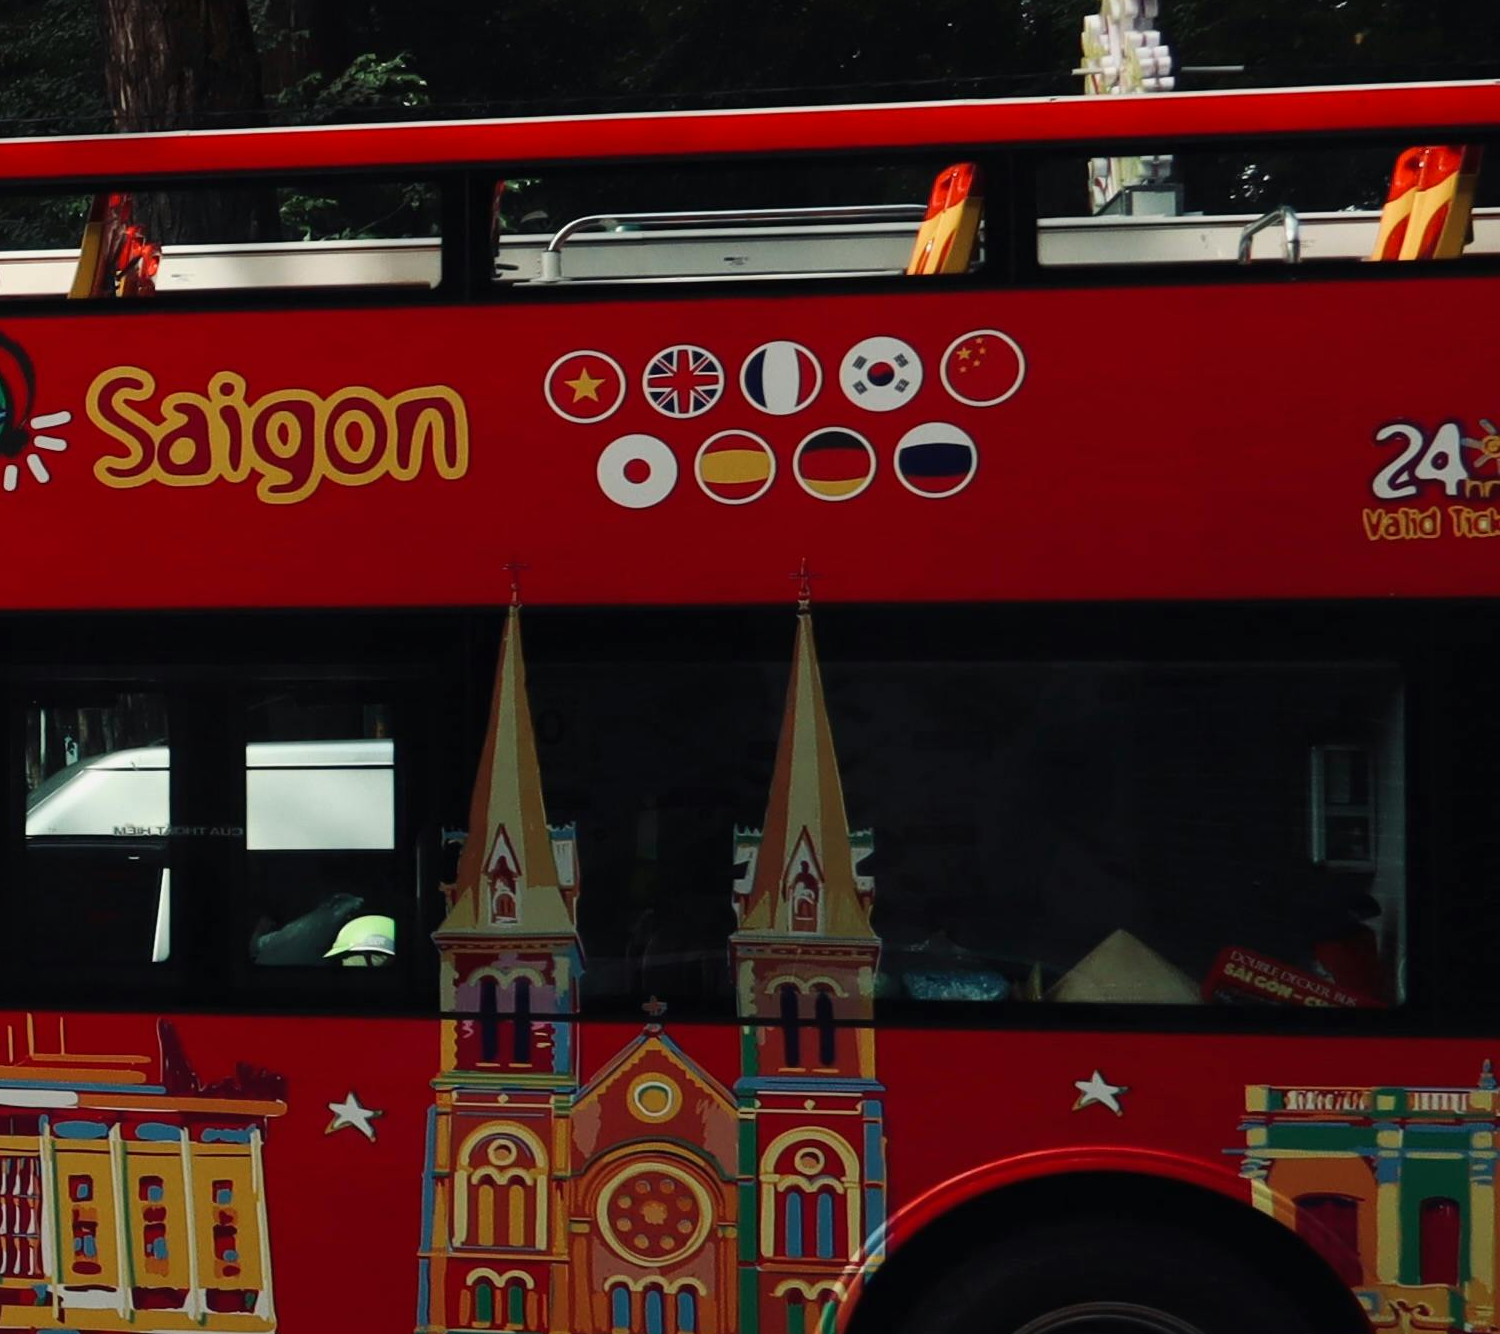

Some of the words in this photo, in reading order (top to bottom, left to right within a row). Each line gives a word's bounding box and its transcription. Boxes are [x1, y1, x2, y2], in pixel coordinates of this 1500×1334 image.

[85, 366, 469, 506] Saigon
[1372, 422, 1468, 499] 24
[1362, 506, 1442, 541] Valid
[1230, 950, 1278, 976] DOUBLE
[1280, 971, 1330, 998] DECKER
